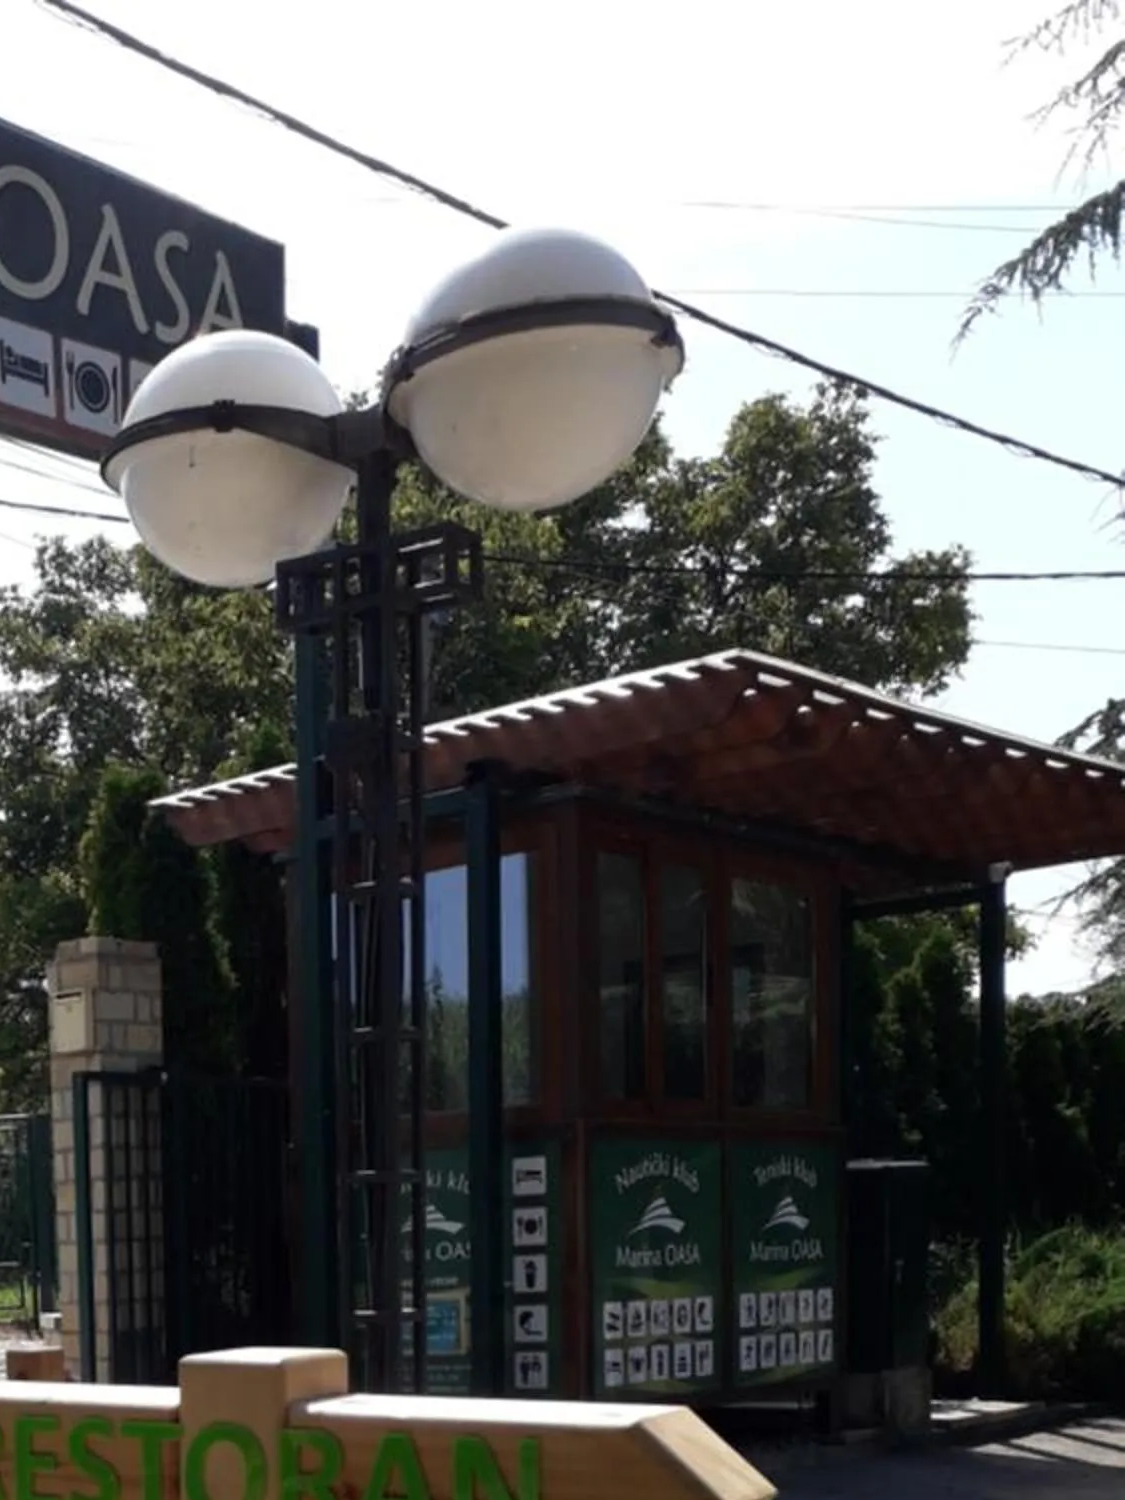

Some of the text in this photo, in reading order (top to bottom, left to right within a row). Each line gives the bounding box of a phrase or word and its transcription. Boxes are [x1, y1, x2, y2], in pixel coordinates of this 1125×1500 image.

[672, 1155, 701, 1194] klub
[793, 1155, 819, 1190] klub
[615, 1241, 702, 1268] Marina OASA
[749, 1237, 825, 1264] Marina OASA
